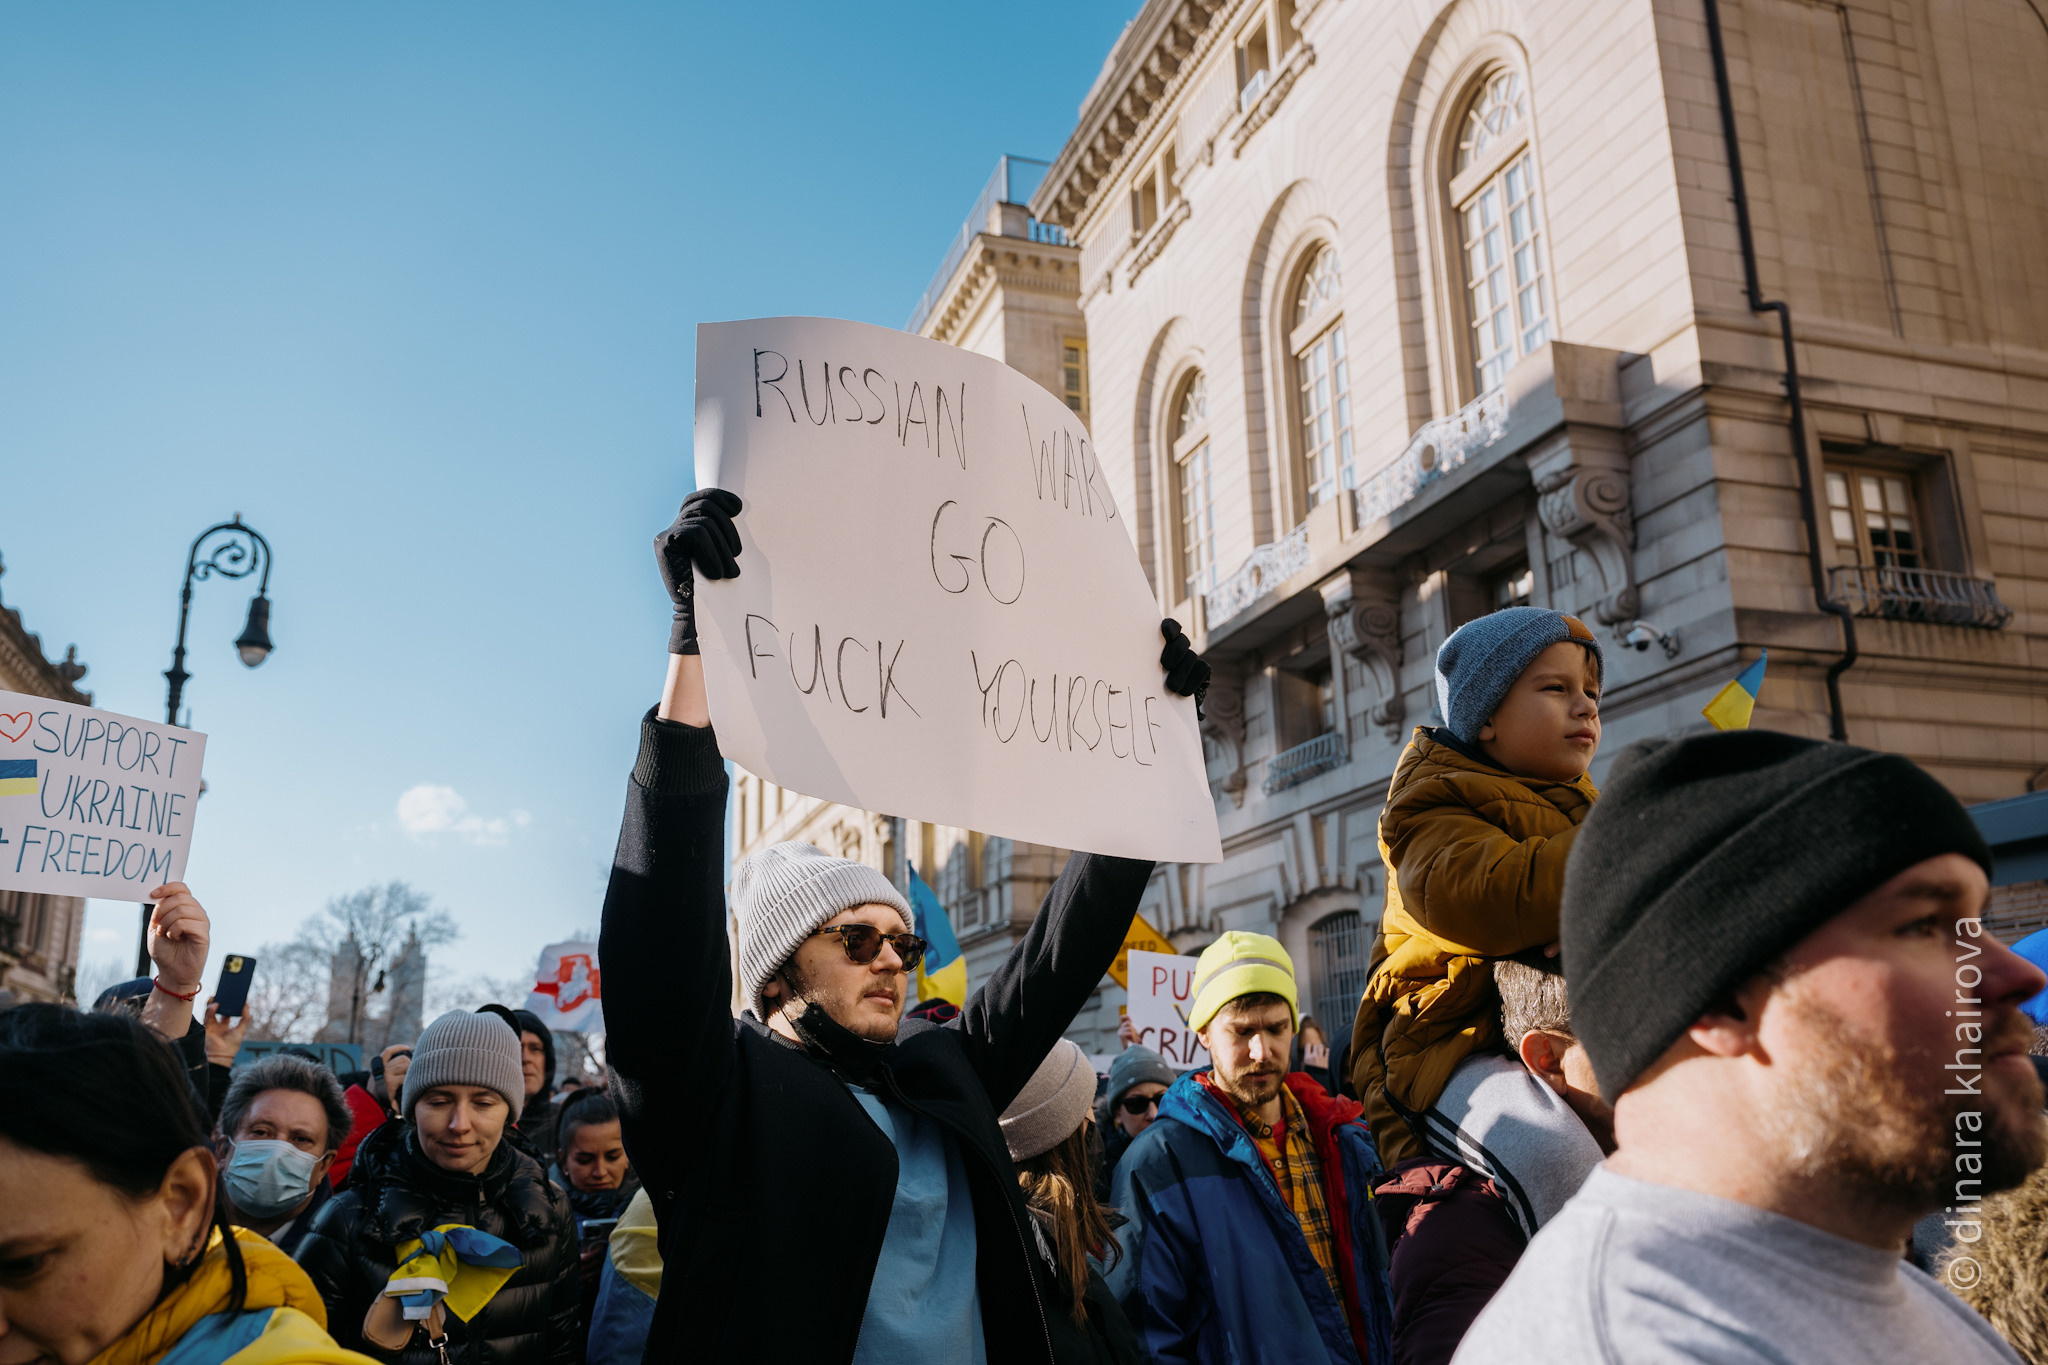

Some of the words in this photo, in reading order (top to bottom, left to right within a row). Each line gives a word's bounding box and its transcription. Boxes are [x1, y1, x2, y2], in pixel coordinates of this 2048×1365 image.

[753, 347, 966, 471] RUSSIAN
[930, 500, 1025, 605] GO
[745, 613, 922, 719] FUCK
[970, 650, 1162, 767] YOURSELF
[33, 711, 188, 778] SUPPORT
[41, 768, 186, 837] UKRAINE
[15, 825, 172, 885] FREEDOM
[1152, 966, 1197, 1001] PU
